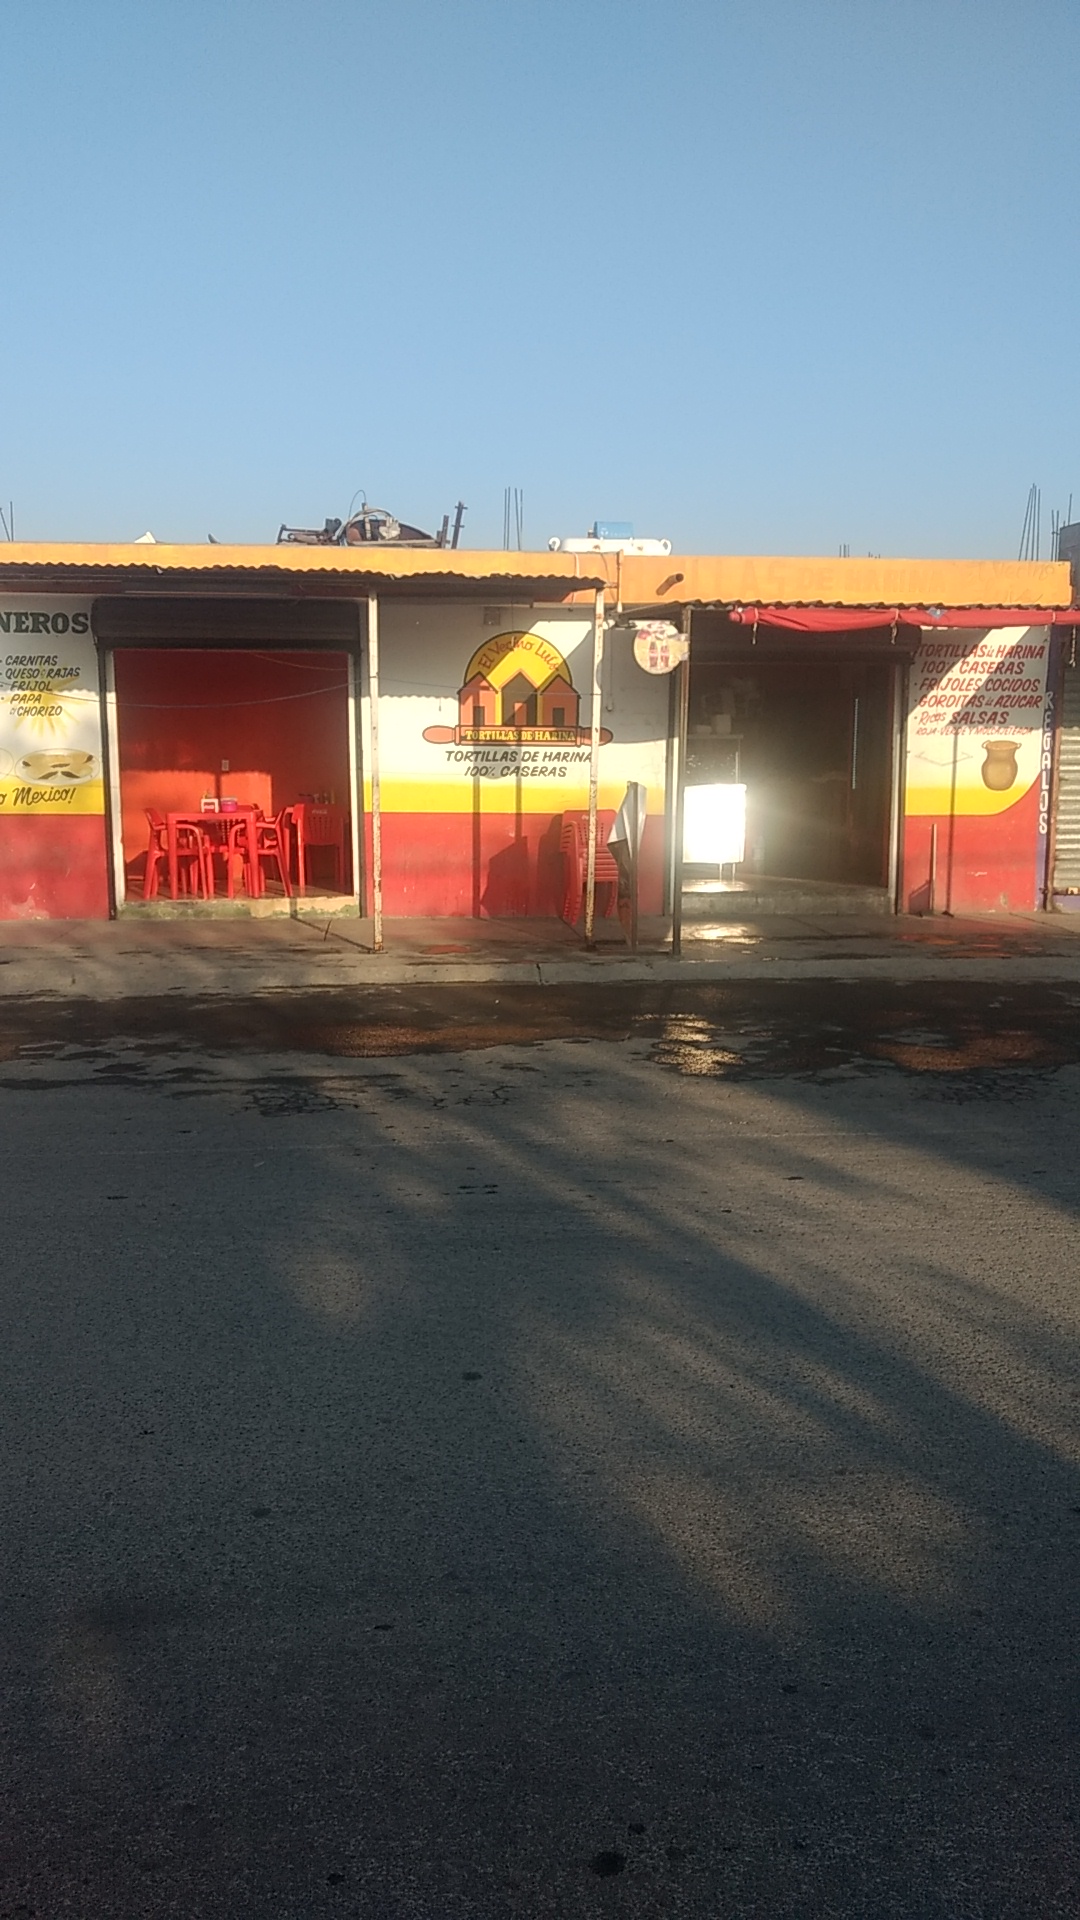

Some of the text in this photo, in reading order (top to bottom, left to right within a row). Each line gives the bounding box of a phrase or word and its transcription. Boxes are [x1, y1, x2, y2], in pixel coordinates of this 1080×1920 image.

[918, 644, 988, 659] TORTILLAS
[995, 644, 1046, 659] HARINA
[5, 655, 59, 667] CARNITAS
[478, 653, 494, 669] El
[960, 661, 1026, 675] CASERAS
[5, 668, 40, 680] QUESO
[10, 680, 53, 692] FRIJOL
[919, 677, 1041, 692] FRIJOLES COCIDOS
[10, 693, 43, 704] PAPA
[919, 694, 986, 709] GORDITAS
[994, 695, 1043, 709] AZUCAR
[950, 711, 1010, 725] SALSAS
[465, 730, 576, 741] TORTILLAS DE HARINA
[445, 751, 518, 763] TORTILLAS
[520, 752, 540, 763] DE
[1039, 691, 1054, 834] REGALOS
[464, 766, 567, 778] 100% CASERAS
[12, 786, 77, 806] Mexico!
